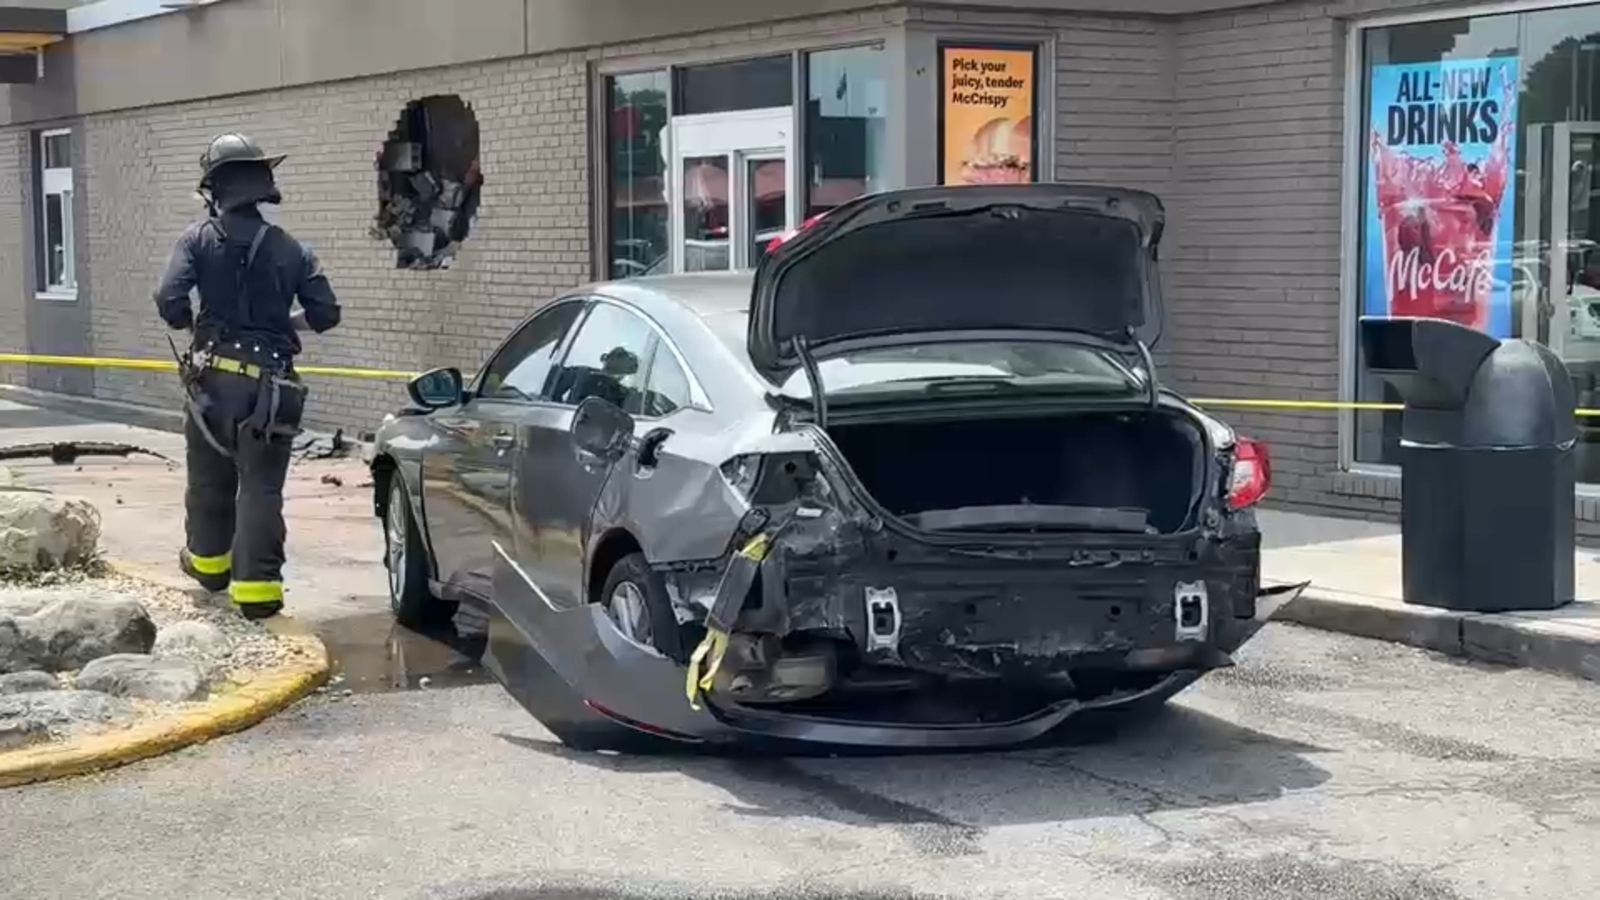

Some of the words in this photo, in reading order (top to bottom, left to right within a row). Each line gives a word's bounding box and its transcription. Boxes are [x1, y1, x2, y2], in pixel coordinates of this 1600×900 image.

[952, 58, 978, 71] Pick
[980, 61, 1006, 74] your
[952, 74, 983, 90] juicy,
[985, 76, 1025, 88] tender
[1397, 68, 1491, 102] ALL-NEW
[952, 92, 1008, 108] McCrispy
[1387, 101, 1499, 146] DRINKS
